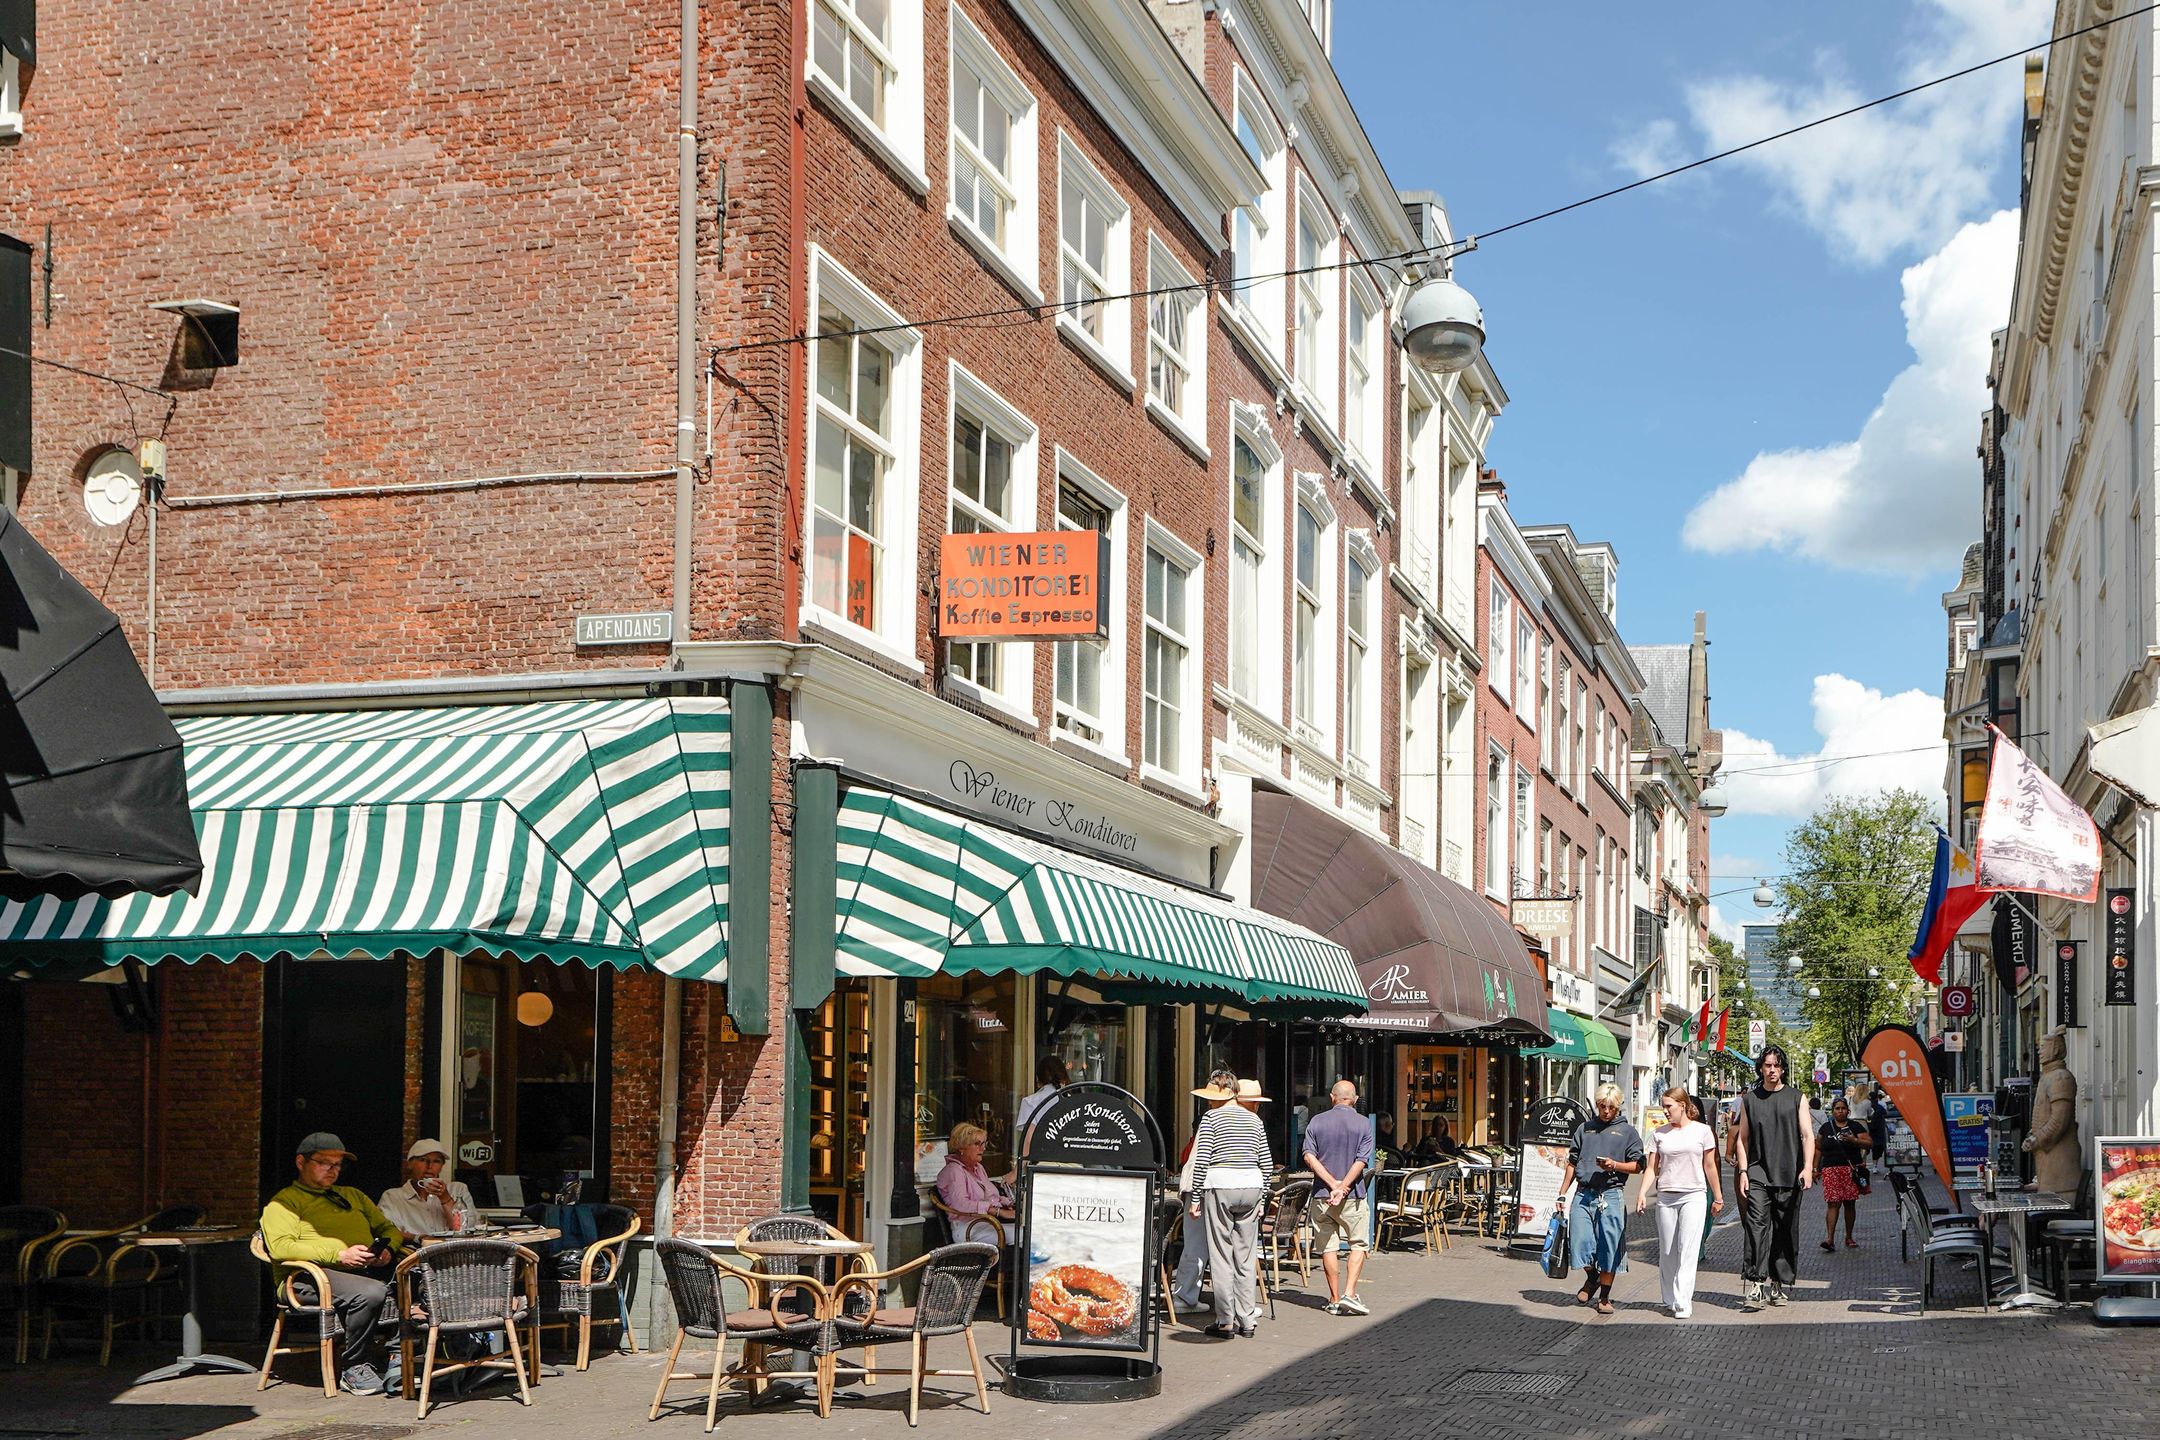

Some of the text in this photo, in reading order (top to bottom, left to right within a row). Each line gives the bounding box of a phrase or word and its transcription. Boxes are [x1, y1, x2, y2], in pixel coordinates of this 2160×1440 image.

[967, 543, 1068, 567] WIENER
[946, 574, 1090, 598] KONDITOREI
[945, 602, 1094, 627] Koffie Espresso
[586, 617, 662, 640] APENDANS
[950, 760, 1138, 852] Wiener Konditorei
[1515, 910, 1569, 923] DREESE
[904, 1002, 914, 1019] 24
[1950, 1101, 1965, 1116] P
[1045, 1103, 1142, 1145] Wiener Konditorei
[1960, 1117, 1983, 1126] GRATIS!
[462, 1147, 491, 1161] WiFi
[1062, 1196, 1118, 1206] TRADITIONELE
[1053, 1204, 1125, 1223] BREZELS
